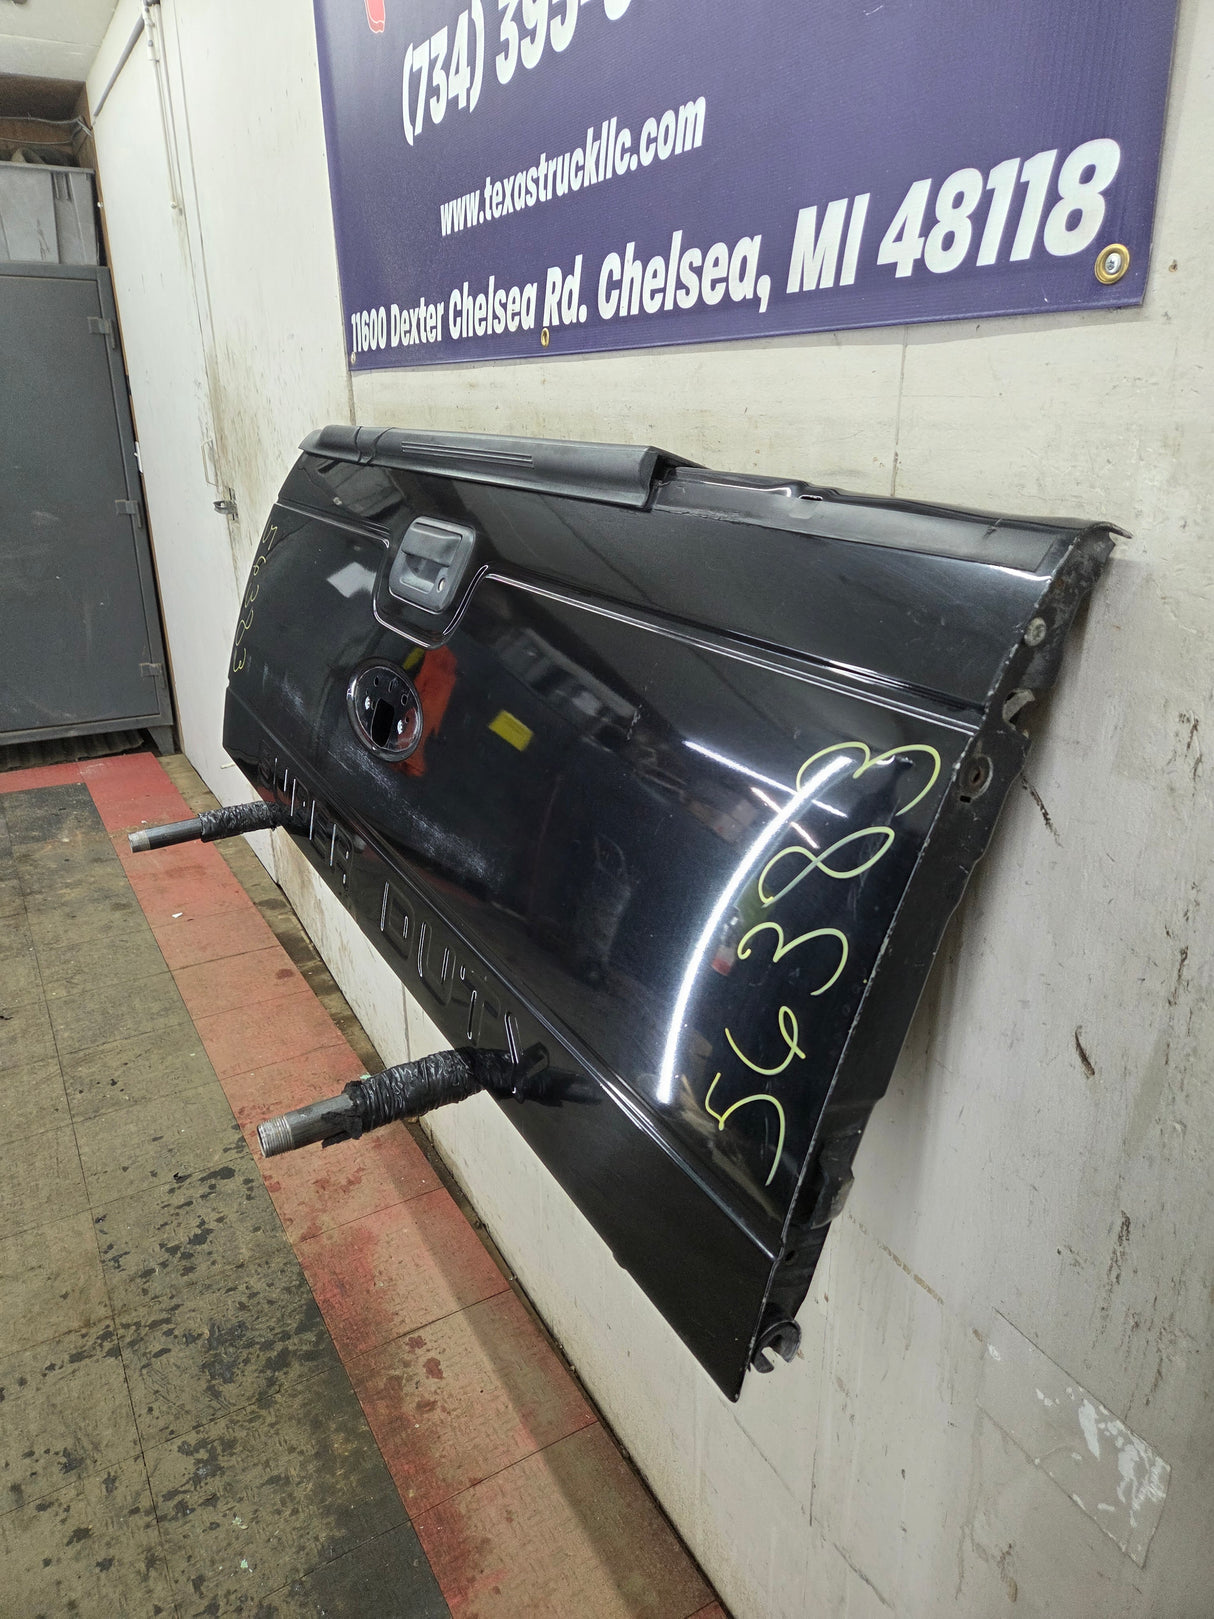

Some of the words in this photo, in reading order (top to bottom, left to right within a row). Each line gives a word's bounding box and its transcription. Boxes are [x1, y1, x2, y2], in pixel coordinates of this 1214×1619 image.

[402, 0, 484, 146] (734)
[495, 0, 632, 85] 395-
[440, 96, 707, 237] www.texastruckllc.com
[351, 307, 387, 353] 11600
[390, 298, 445, 348] Dexter
[448, 275, 538, 340] Chelsea
[543, 254, 588, 327] Rd.
[598, 230, 772, 320] Chelsea,
[786, 193, 871, 294] MI
[877, 138, 1121, 279] 48118
[380, 879, 549, 1105] DUTY
[704, 741, 941, 1187] 56383
